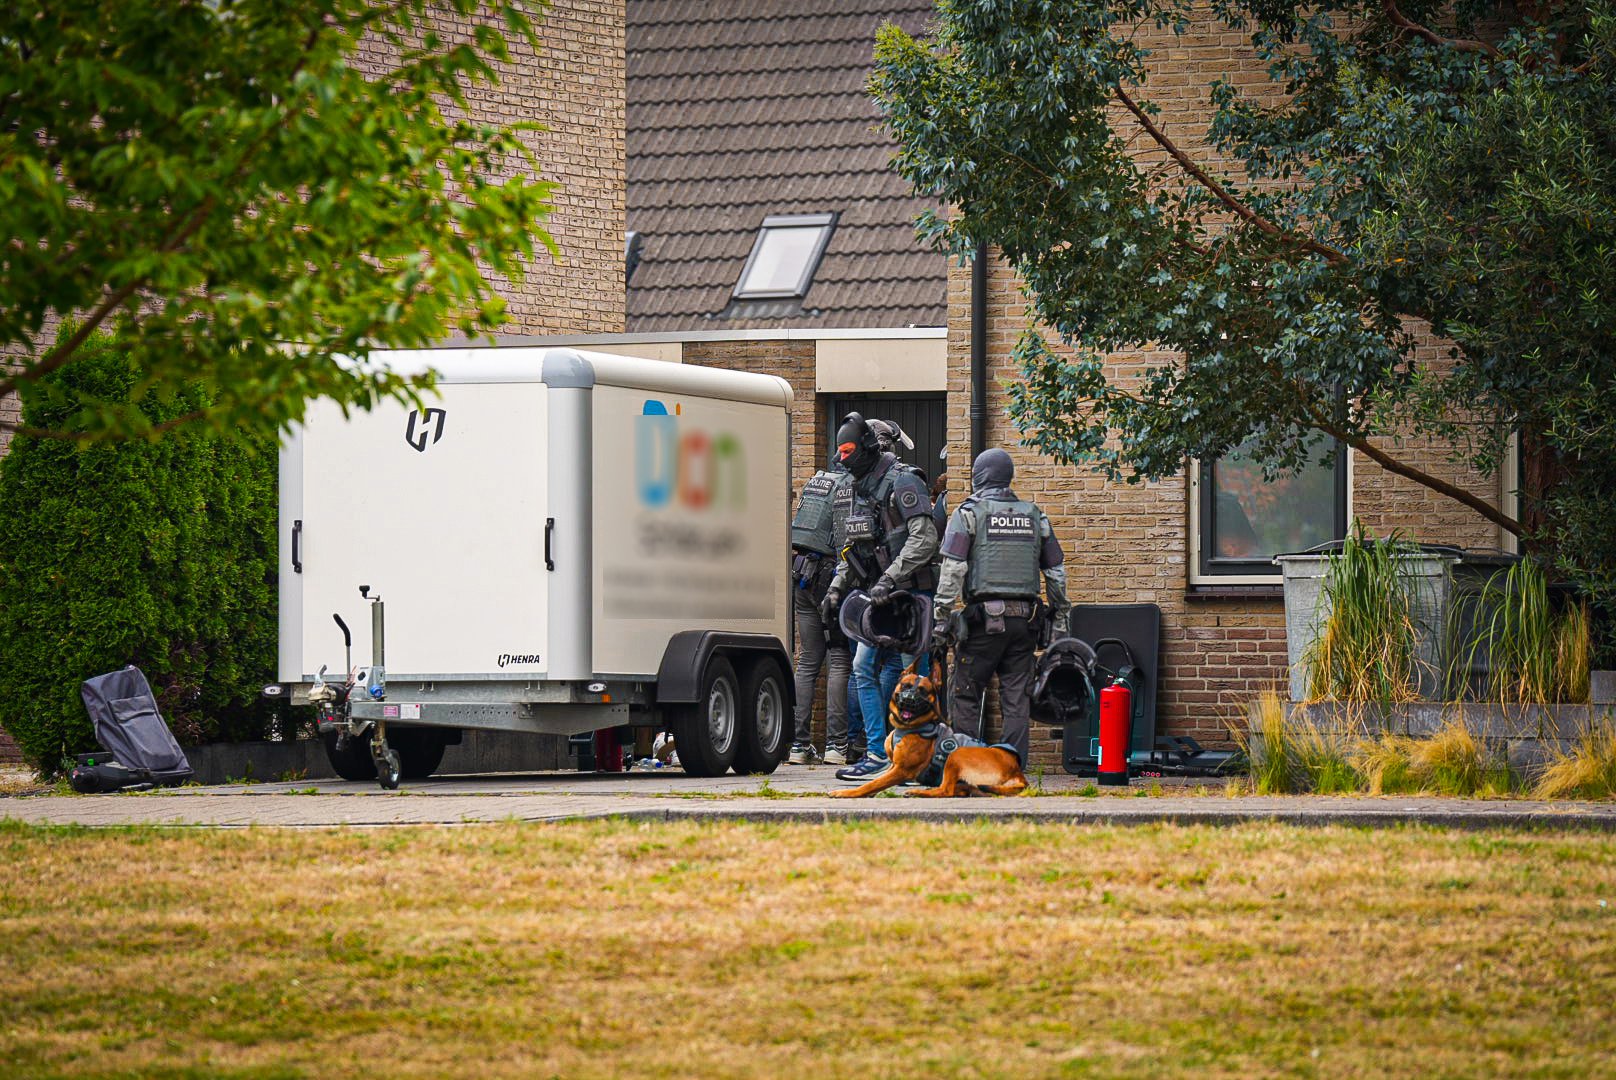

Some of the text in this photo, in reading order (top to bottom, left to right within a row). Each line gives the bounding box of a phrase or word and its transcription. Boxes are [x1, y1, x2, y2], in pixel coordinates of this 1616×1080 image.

[808, 478, 832, 488] POLITIE
[836, 488, 852, 497] POLIT
[991, 516, 1031, 527] POLITIE
[511, 654, 540, 664] HENRA
